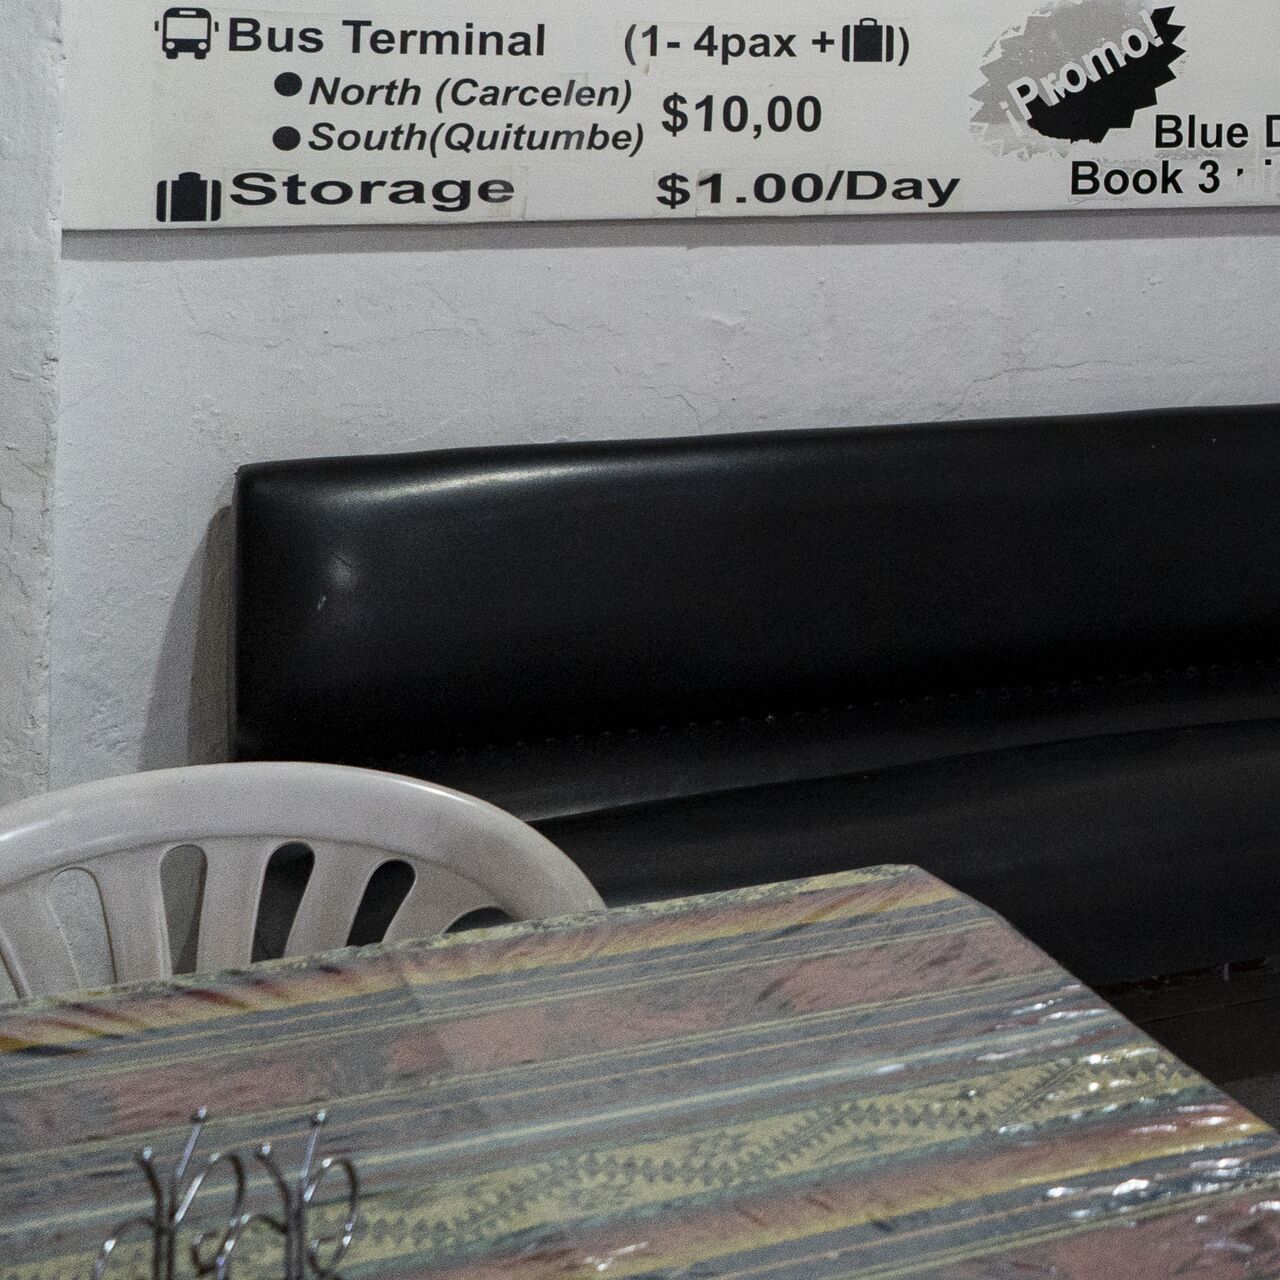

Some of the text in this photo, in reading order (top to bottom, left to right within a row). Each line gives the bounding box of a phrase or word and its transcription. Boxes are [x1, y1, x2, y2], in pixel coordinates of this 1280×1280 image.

[228, 16, 324, 54] Bus
[341, 19, 546, 57] Terminal
[693, 24, 797, 66] 4pax
[1000, 10, 1170, 133] ¡Promo!
[308, 76, 632, 115] North (Carcelen)
[661, 91, 822, 140] $10,00
[307, 121, 644, 159] South(Quitumbe)
[1154, 113, 1249, 149] Blue
[229, 169, 961, 213] Storage $1.00/Day
[1070, 159, 1184, 196] Book
[1198, 159, 1221, 195] 3
